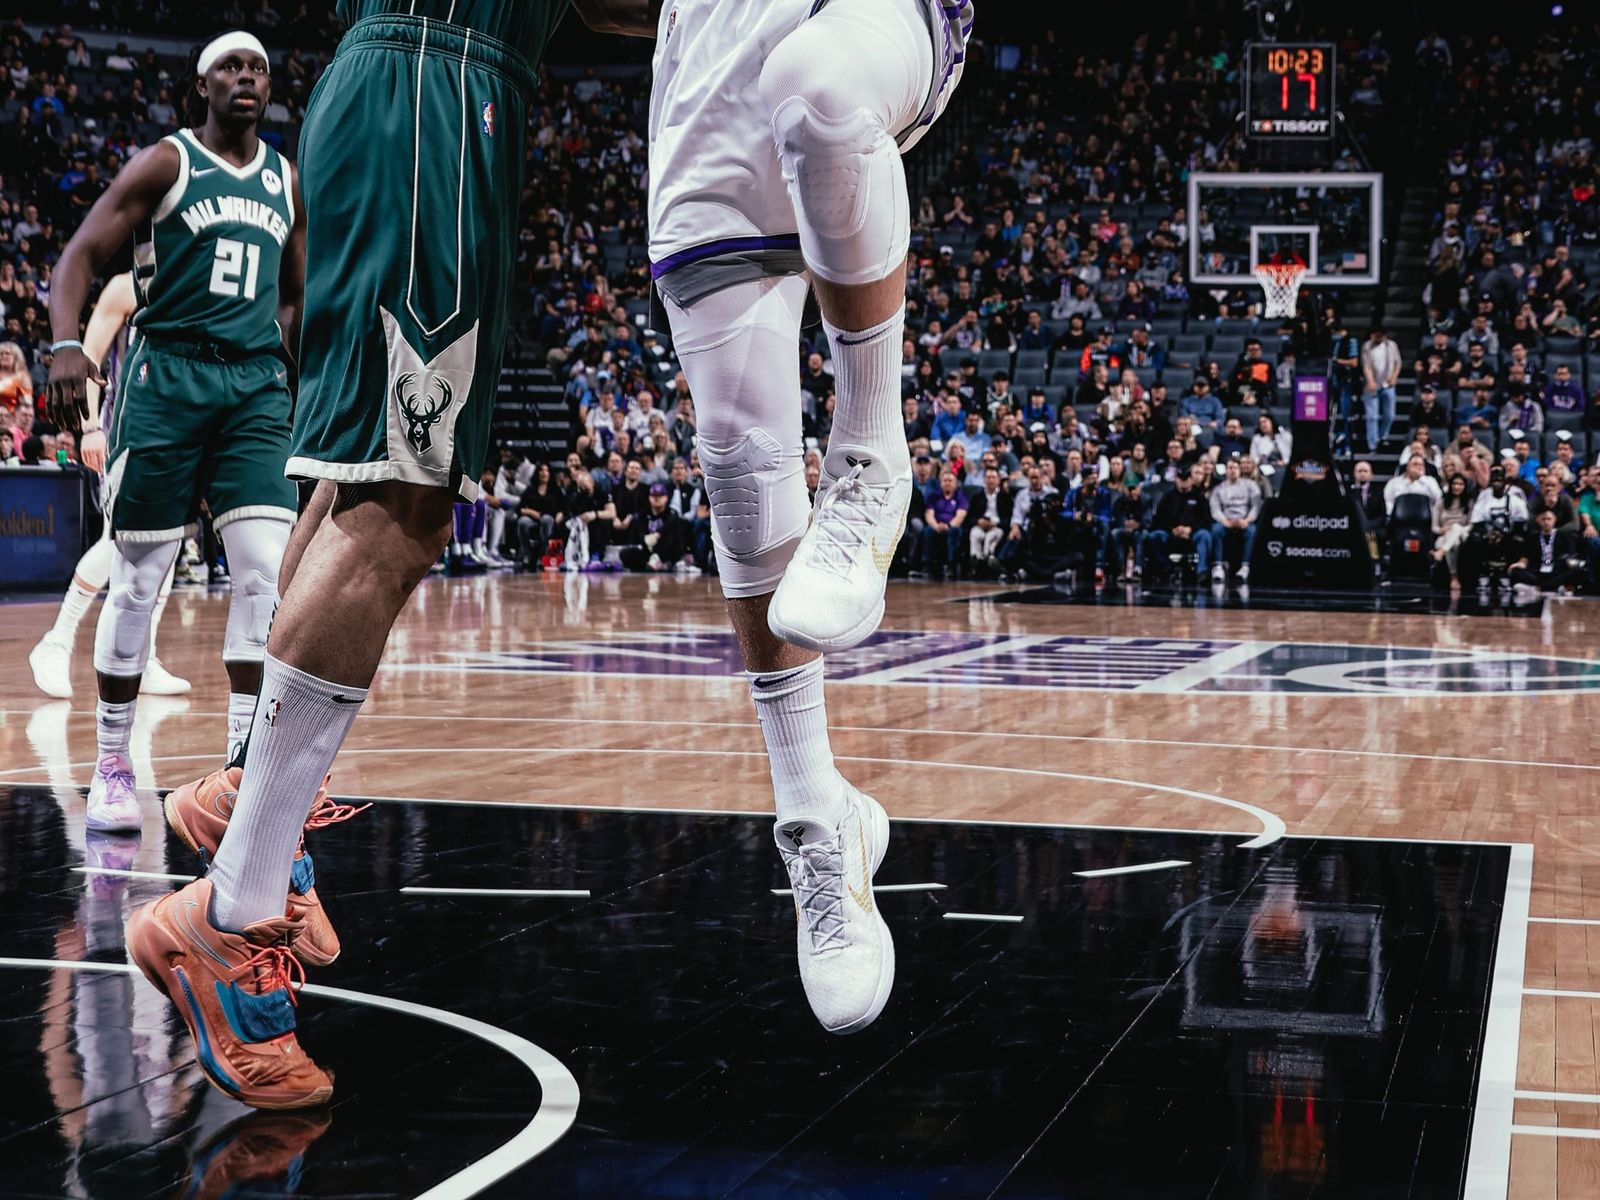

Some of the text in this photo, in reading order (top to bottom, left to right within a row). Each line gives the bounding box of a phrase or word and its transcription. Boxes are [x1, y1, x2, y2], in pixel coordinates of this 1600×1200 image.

[1268, 48, 1324, 75] 10:23
[1280, 72, 1317, 112] 17
[1273, 120, 1329, 133] TISSOT
[180, 194, 290, 248] MILWAUKEE
[208, 236, 261, 301] 21
[0, 506, 46, 537] olden
[1292, 514, 1350, 532] dialpad
[1285, 545, 1352, 558] socios.com
